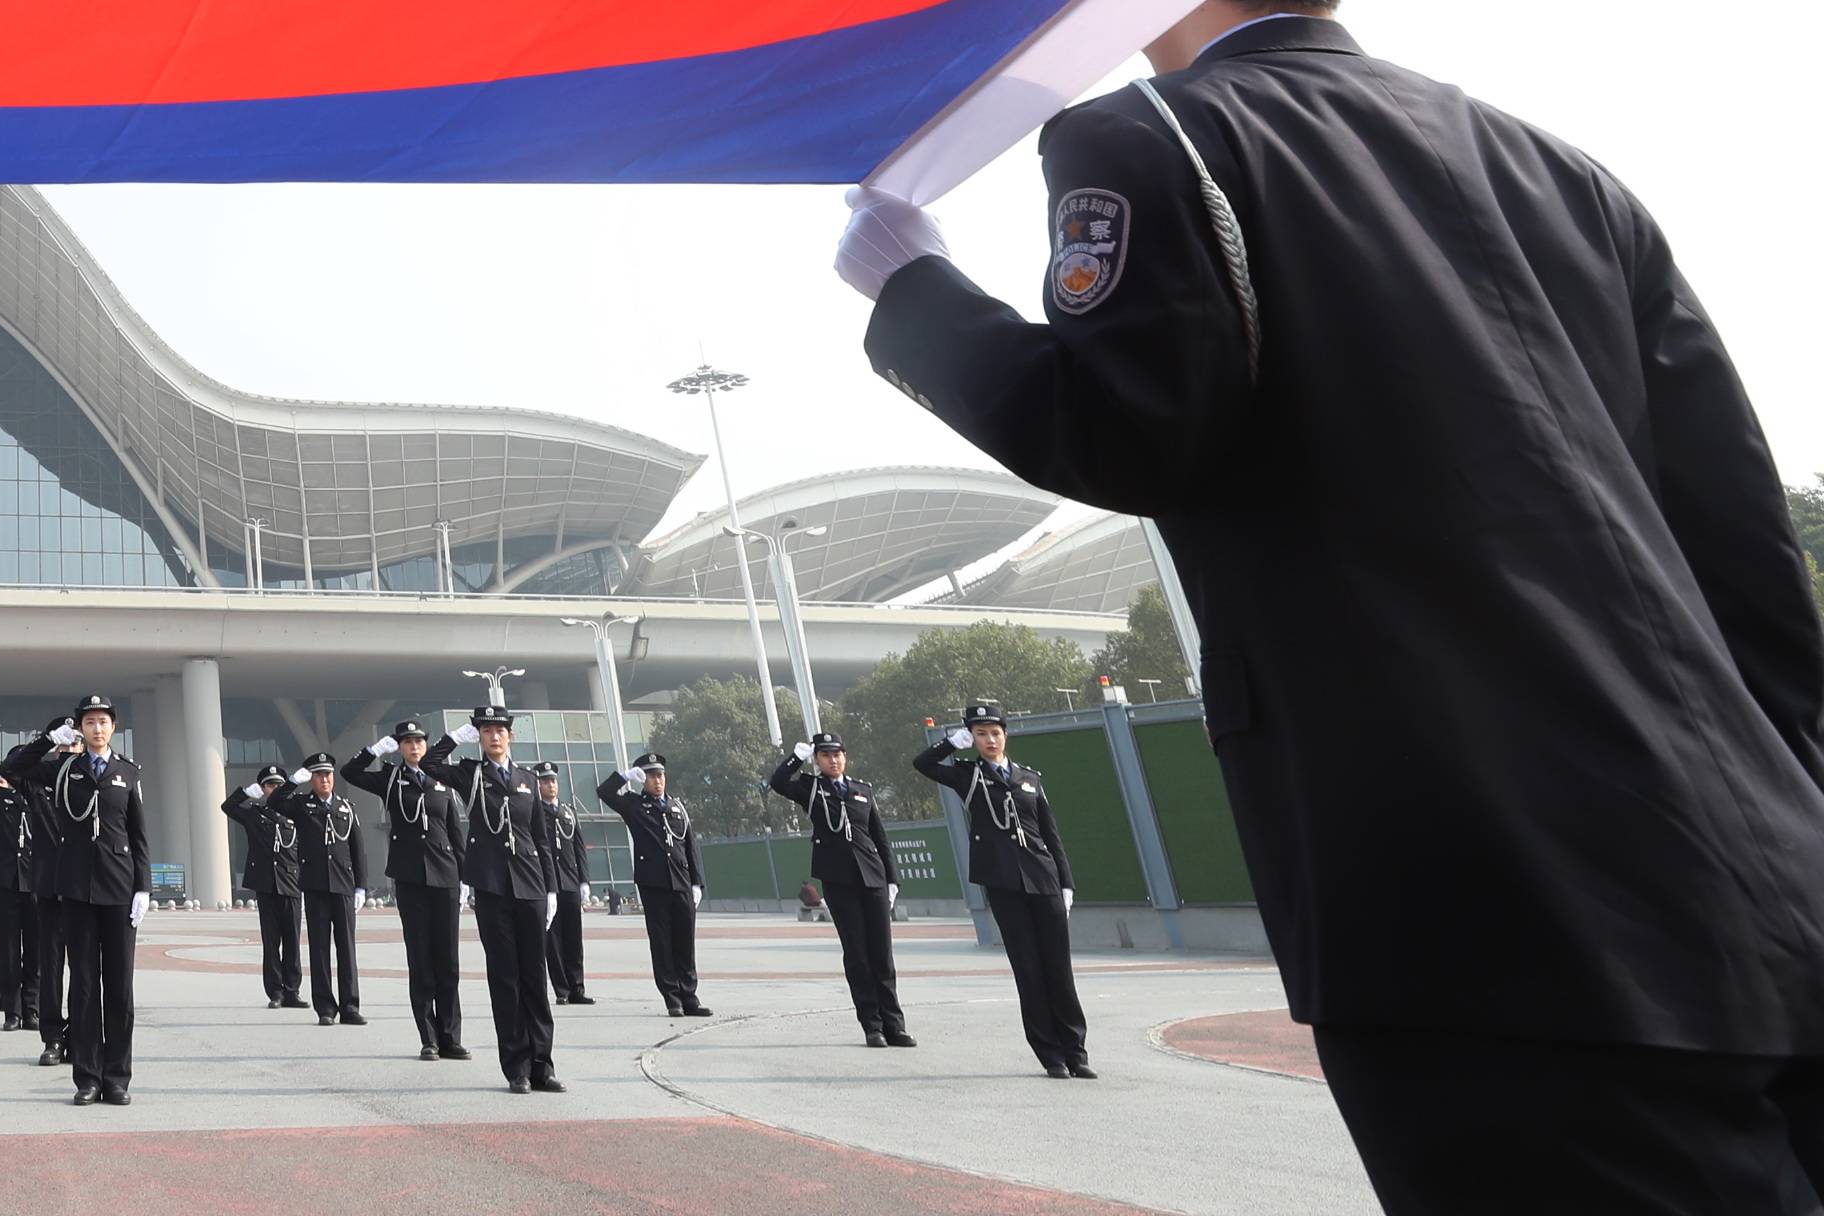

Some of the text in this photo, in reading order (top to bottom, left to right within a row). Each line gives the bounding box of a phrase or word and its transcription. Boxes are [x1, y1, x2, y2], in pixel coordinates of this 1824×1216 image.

[1059, 196, 1118, 224] 人民共和国
